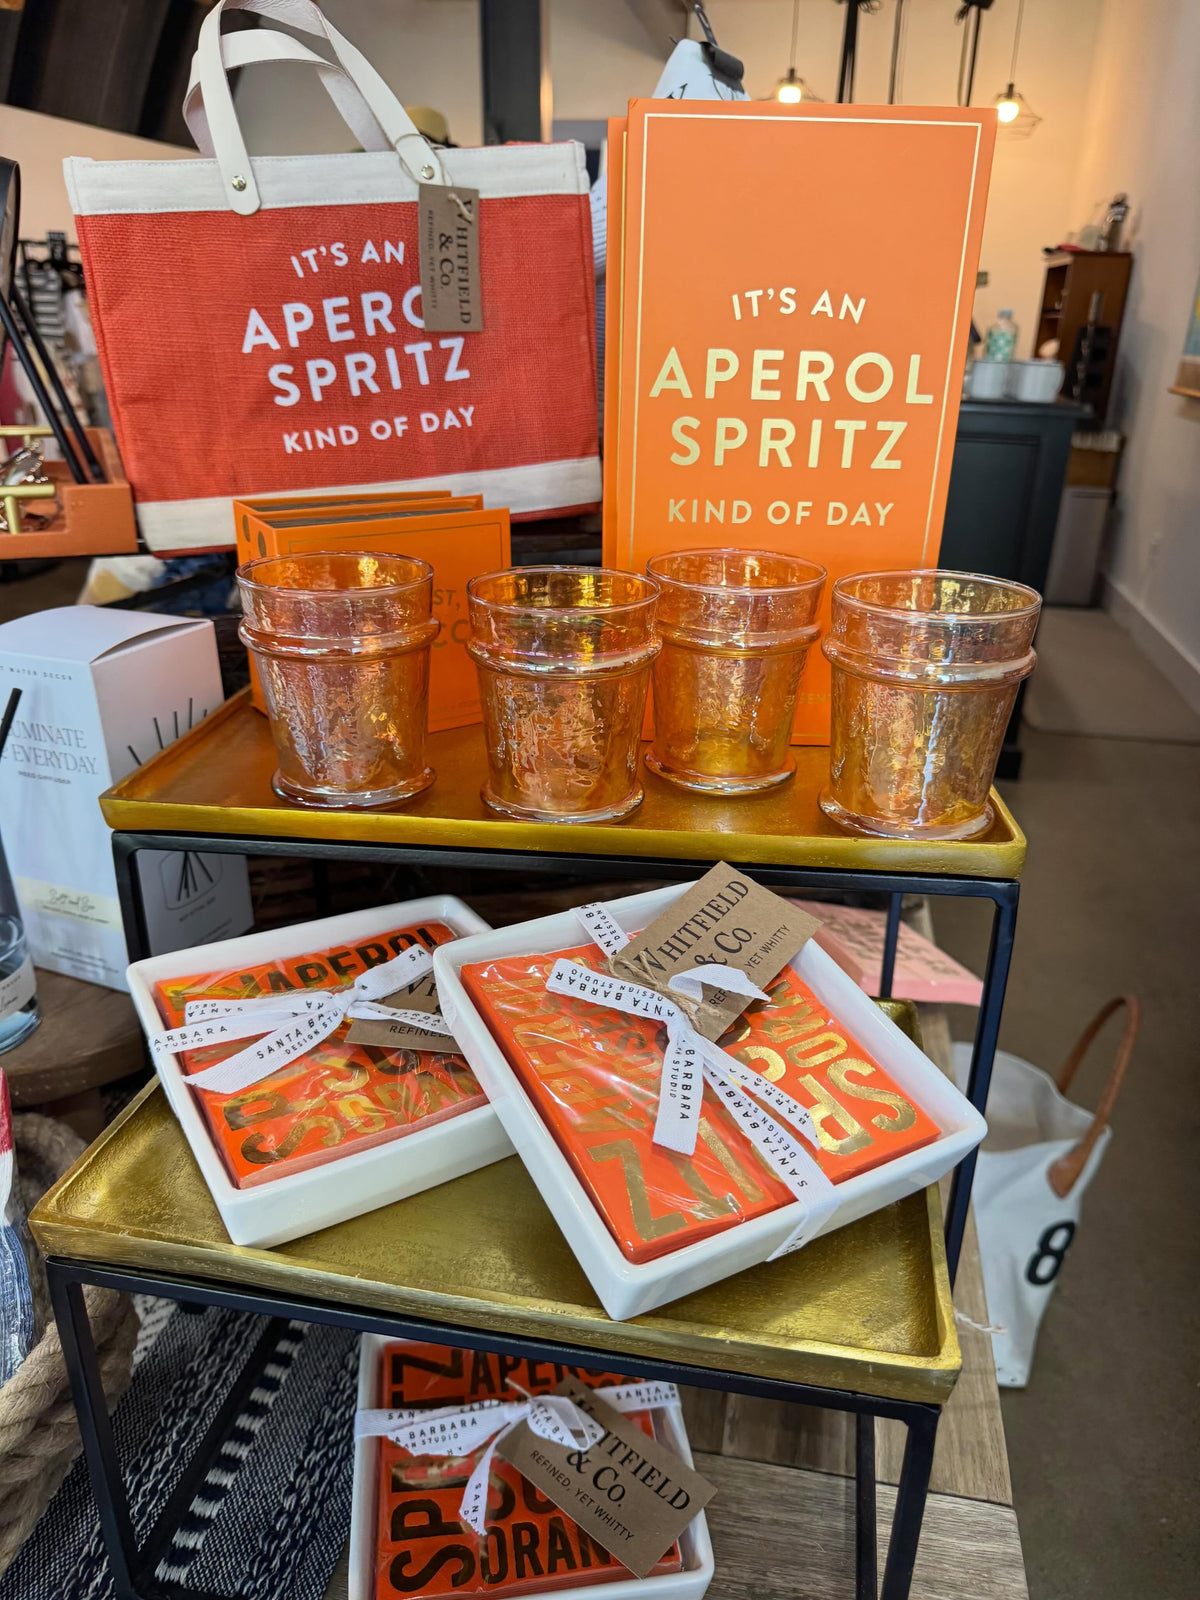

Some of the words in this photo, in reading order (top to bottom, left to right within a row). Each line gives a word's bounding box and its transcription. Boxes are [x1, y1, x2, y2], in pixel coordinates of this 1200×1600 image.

[290, 242, 349, 278] IT'S
[360, 239, 405, 265] AN
[438, 232, 454, 253] &
[241, 285, 426, 354] APERO
[731, 287, 797, 321] IT'S
[810, 289, 867, 325] AN
[267, 337, 471, 407] SPRITZ
[648, 346, 935, 405] APEROL
[282, 425, 359, 454] KIND
[370, 416, 409, 441] OF
[419, 405, 475, 433] DAY
[669, 415, 909, 470] SPRITZ
[667, 498, 753, 524] KIND
[766, 500, 813, 526] OF
[826, 501, 895, 527] DAY
[10, 719, 88, 749] UMINATE
[593, 923, 619, 956] ANTA
[624, 880, 749, 980] WHITFIELD
[744, 951, 763, 969] YET
[759, 924, 791, 954] WHITTY
[555, 971, 623, 1001] BARBAR
[571, 968, 614, 989] STUDIO
[631, 996, 675, 1018] ANTA
[152, 1025, 229, 1047] ARBARA
[256, 1028, 303, 1059] SANTA
[284, 1028, 321, 1055] DESIGN
[669, 1060, 681, 1099] STUDIO
[679, 1049, 696, 1120] BARBARA
[586, 1057, 918, 1243] SPITZ
[760, 1116, 797, 1159] DESIGN
[762, 1136, 808, 1187] SANTA
[1024, 1220, 1077, 1286] 8
[408, 1417, 478, 1439] BARBARA
[421, 1432, 459, 1446] STUDIO
[566, 1449, 592, 1475] &
[590, 1421, 691, 1511] ITFIELD
[471, 1482, 482, 1524] SANT
[529, 1449, 572, 1492] REFINED,
[573, 1487, 596, 1506] YET
[593, 1503, 636, 1542] WHITTY
[479, 1515, 612, 1586] ORAN
